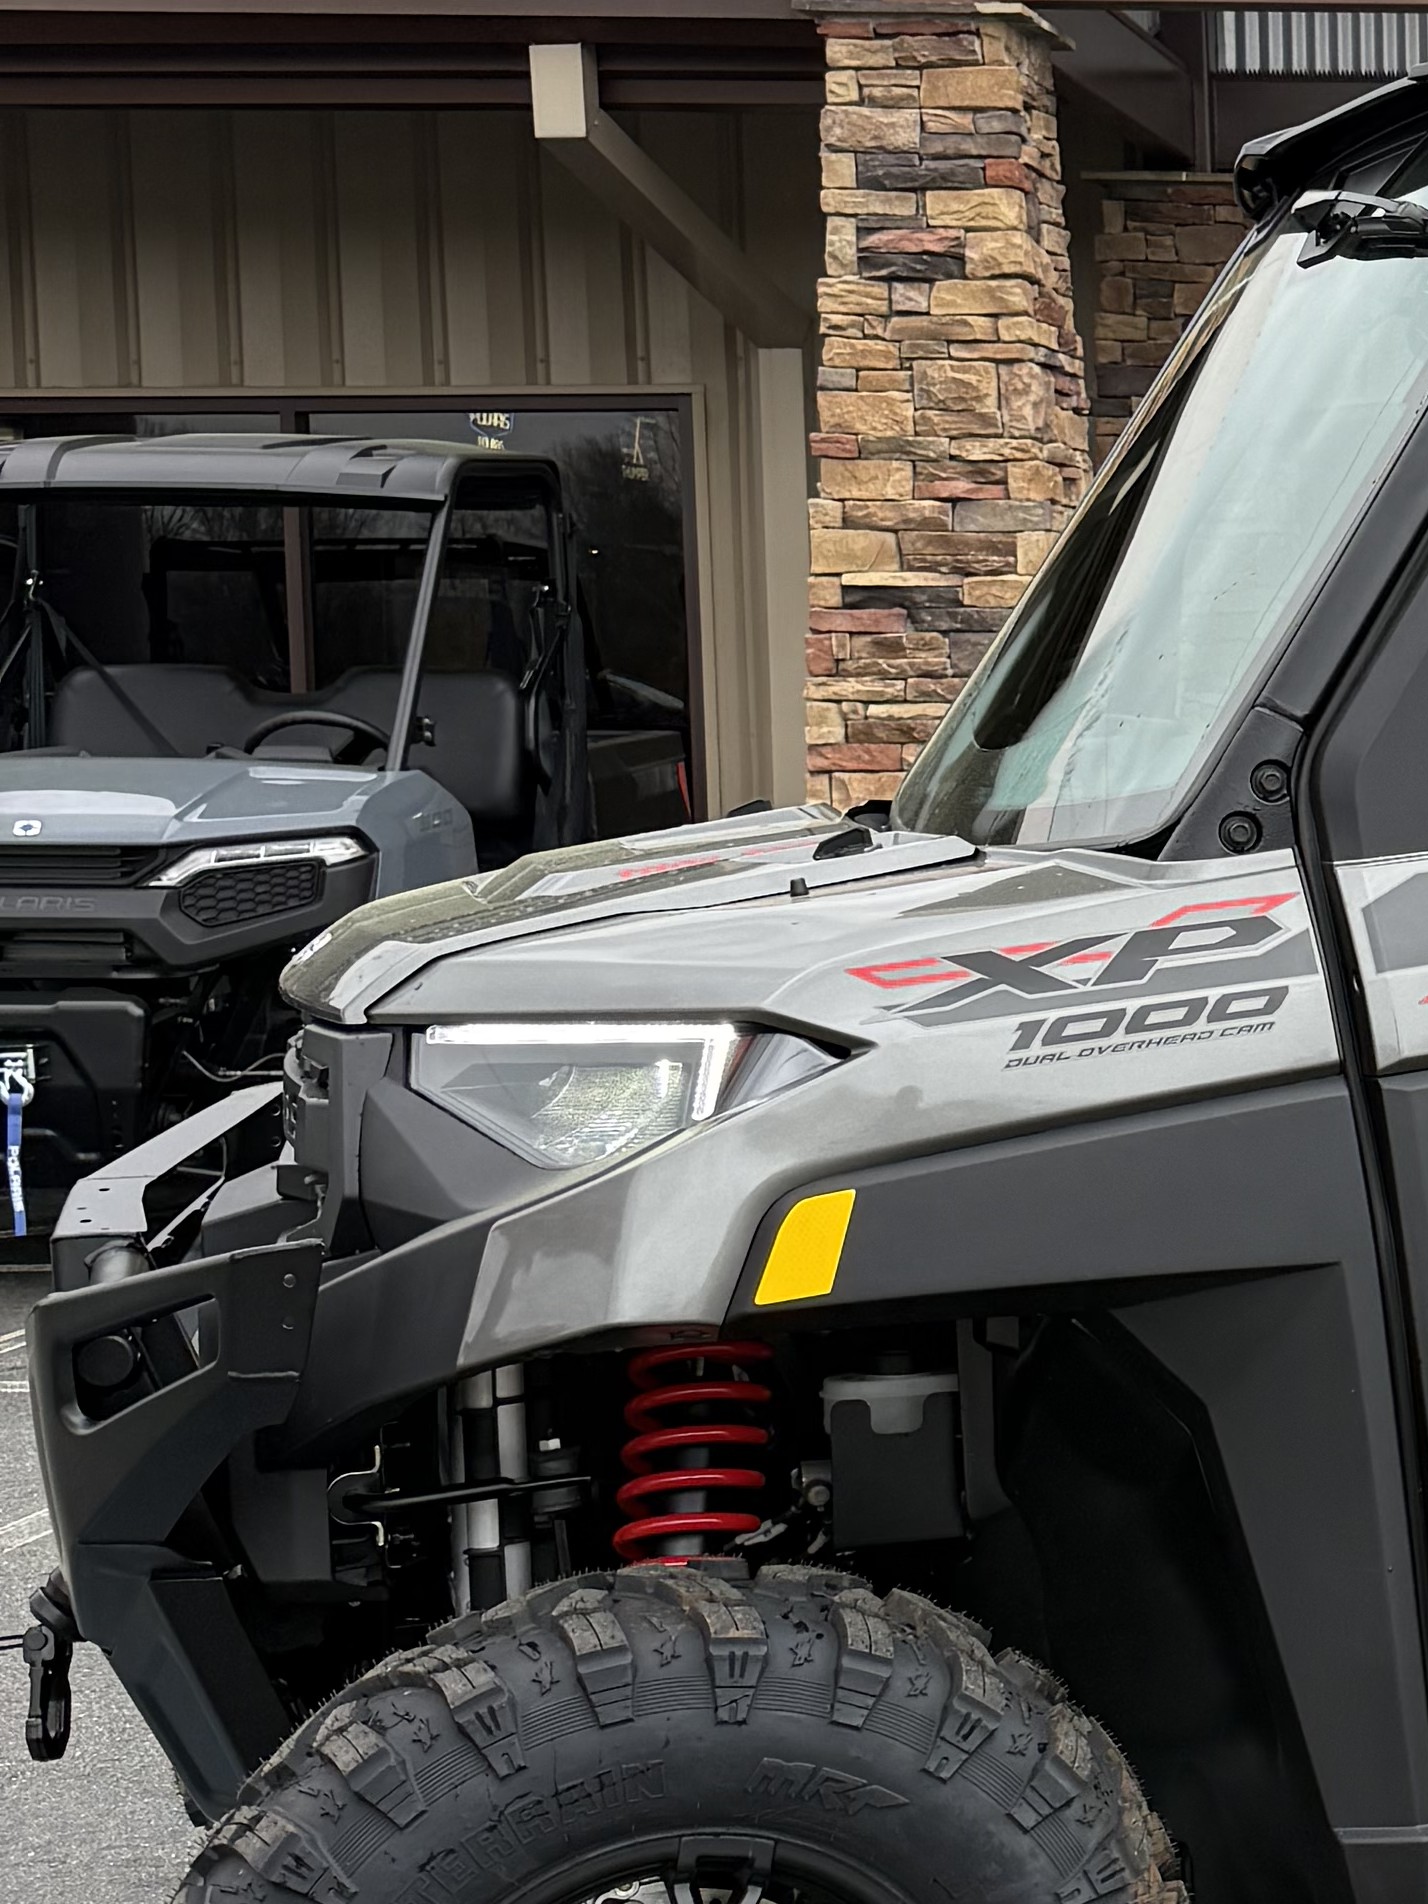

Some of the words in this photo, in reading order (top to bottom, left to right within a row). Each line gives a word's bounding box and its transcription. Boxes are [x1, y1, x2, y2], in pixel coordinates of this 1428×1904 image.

[880, 915, 1285, 1014] XP
[1004, 1051, 1071, 1069] DUAL
[1078, 1030, 1213, 1058] OVERHEAD
[1219, 1021, 1276, 1038] CAM
[1009, 986, 1290, 1052] 1000
